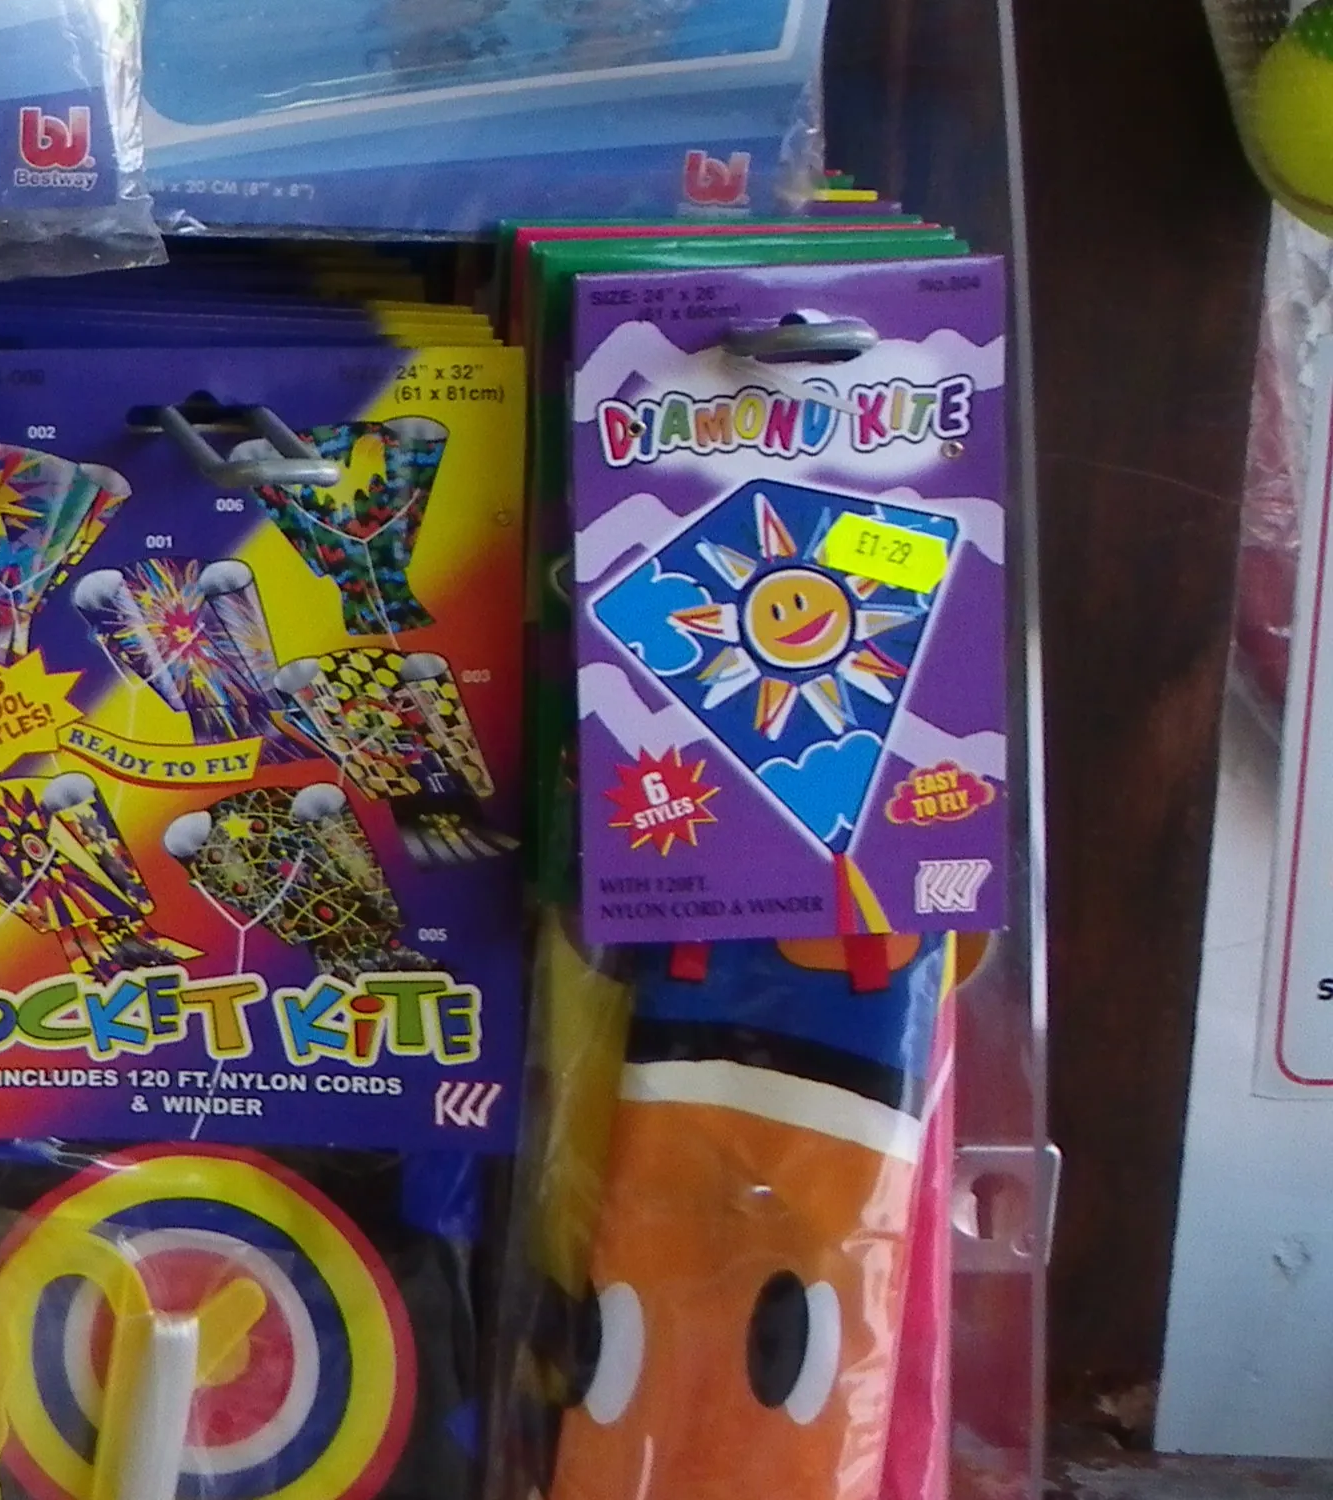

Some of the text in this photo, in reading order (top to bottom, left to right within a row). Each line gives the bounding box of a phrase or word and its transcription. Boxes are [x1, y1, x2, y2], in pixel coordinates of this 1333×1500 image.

[13, 167, 99, 192] Bestway
[434, 366, 445, 380] x
[393, 383, 505, 404] (61 x 81cm)
[27, 425, 57, 440] 002
[598, 377, 973, 466] DIAMOND KITE
[145, 534, 174, 549] 001
[67, 728, 253, 779] READY TO FLY
[641, 771, 666, 805] 6
[914, 769, 960, 796] EASY
[633, 796, 696, 832] STYLES
[911, 789, 970, 820] TO FLY
[127, 1070, 172, 1089] 120
[218, 1072, 310, 1092] NYLON
[315, 1074, 403, 1095] CORDS
[131, 1094, 264, 1117] & WINDER
